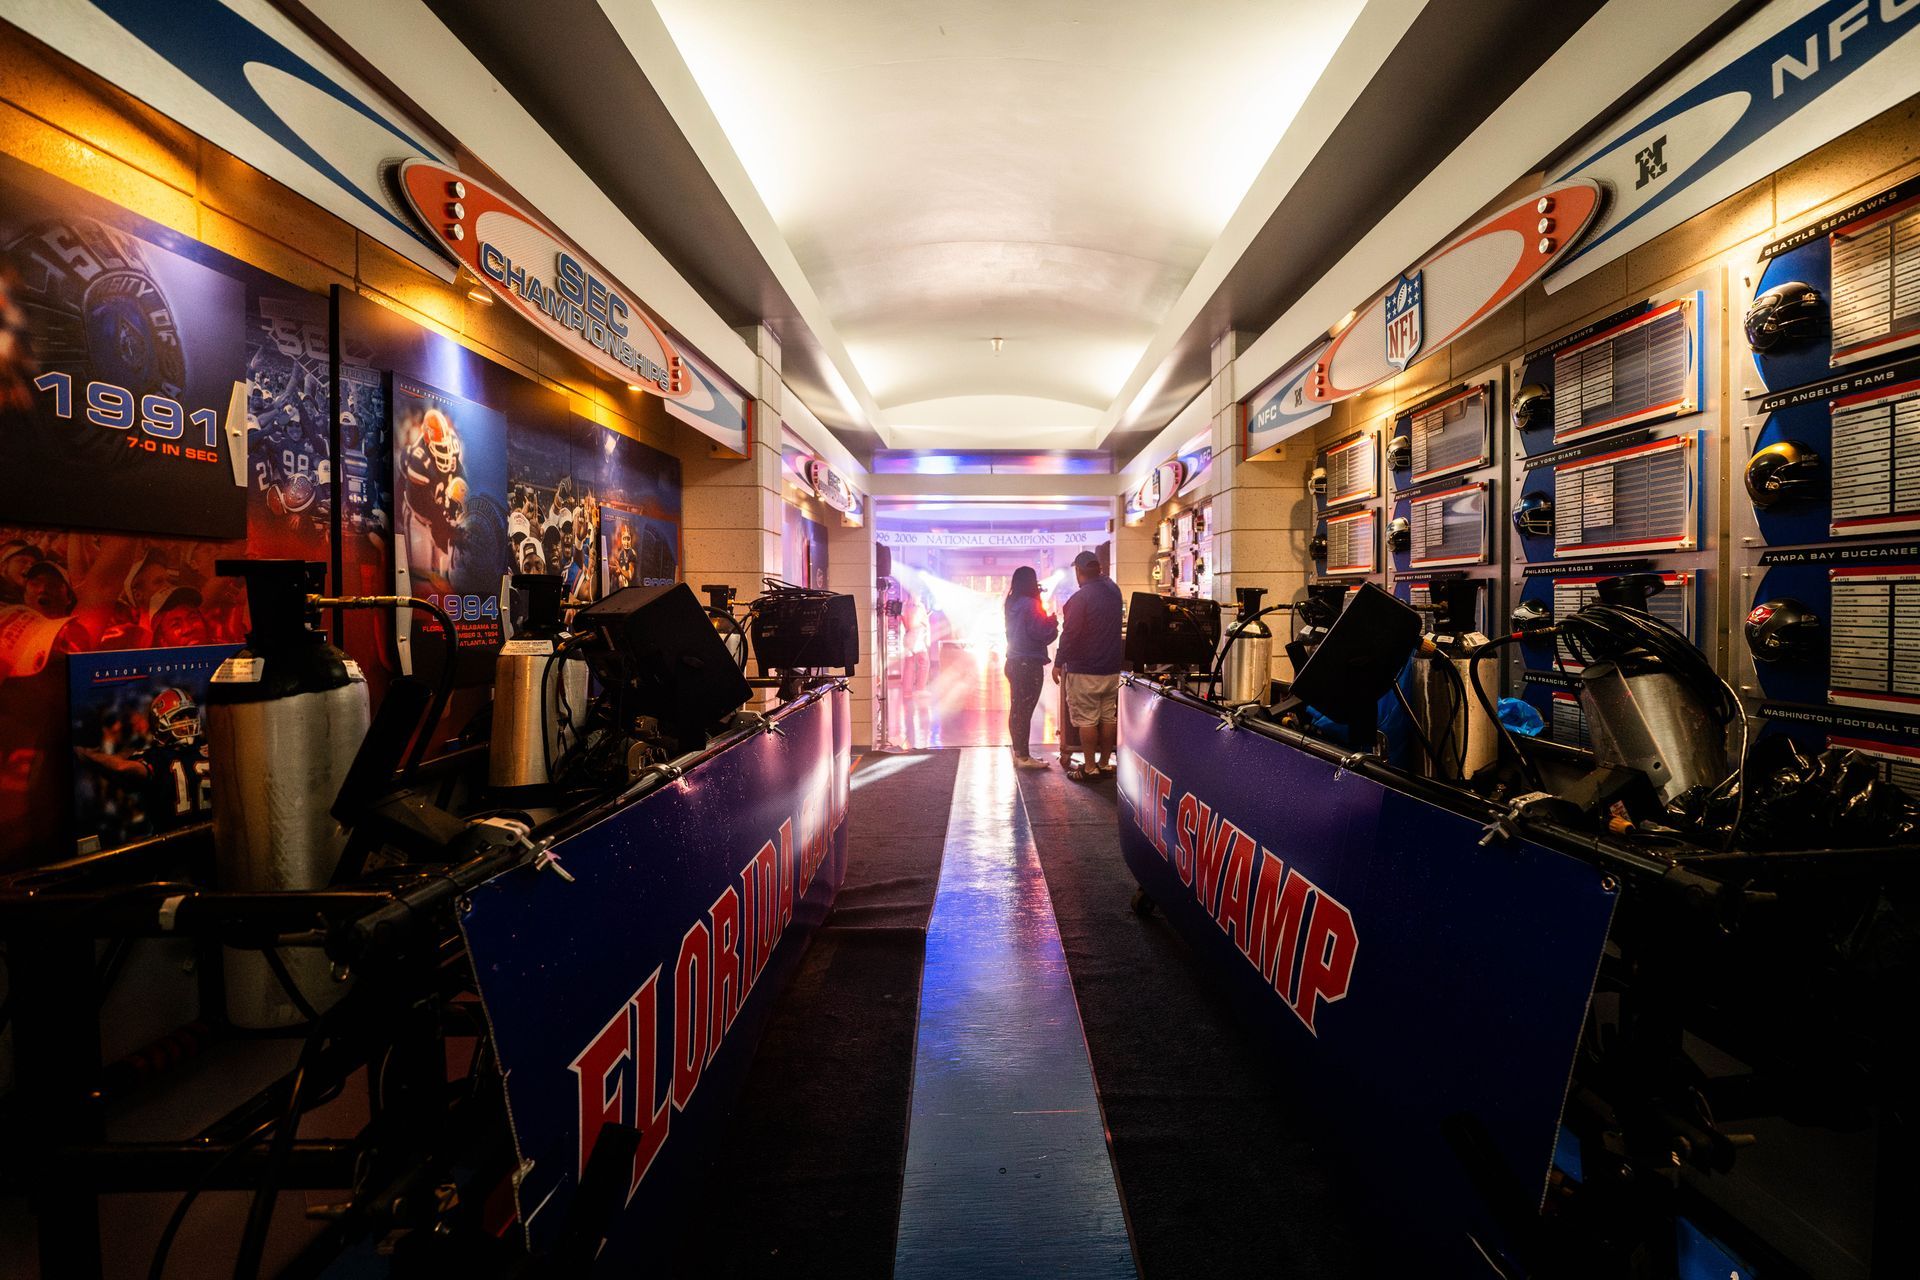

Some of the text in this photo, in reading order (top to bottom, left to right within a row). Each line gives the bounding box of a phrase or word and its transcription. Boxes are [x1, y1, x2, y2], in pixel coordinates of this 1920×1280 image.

[1764, 191, 1898, 256] SEATTLE SEAHAWKS
[556, 251, 629, 338] SEC
[480, 241, 670, 392] CHAMPIONSHIPS
[1388, 310, 1418, 359] NFL
[1539, 339, 1567, 355] ORLEANS
[1570, 327, 1594, 342] SAINTS
[1764, 371, 1896, 410] LOS ANGELES RAMS
[33, 371, 217, 448] 1991
[1257, 405, 1278, 429] NFC
[126, 436, 218, 463] 7-0 IN SEC
[1526, 449, 1582, 468] NEW YORK GIANTS
[895, 533, 918, 543] 2006
[926, 535, 985, 545] NATIONAL
[988, 534, 1056, 545] CHAMPIONS
[1525, 567, 1566, 575] PHILADELPHIA
[1765, 553, 1805, 563] TAMPA
[1810, 552, 1836, 560] BAY
[426, 594, 498, 622] 1994
[462, 623, 489, 631] ALABAMA
[95, 668, 138, 678] GATOR
[149, 662, 210, 674] FOOTBALL
[1538, 677, 1568, 686] FRANCISC
[1763, 708, 1833, 724] WASHINGTON
[1836, 717, 1899, 732] FOOTBALL
[1174, 791, 1360, 1039] SWAMP
[567, 816, 794, 1210] FLORIDA
